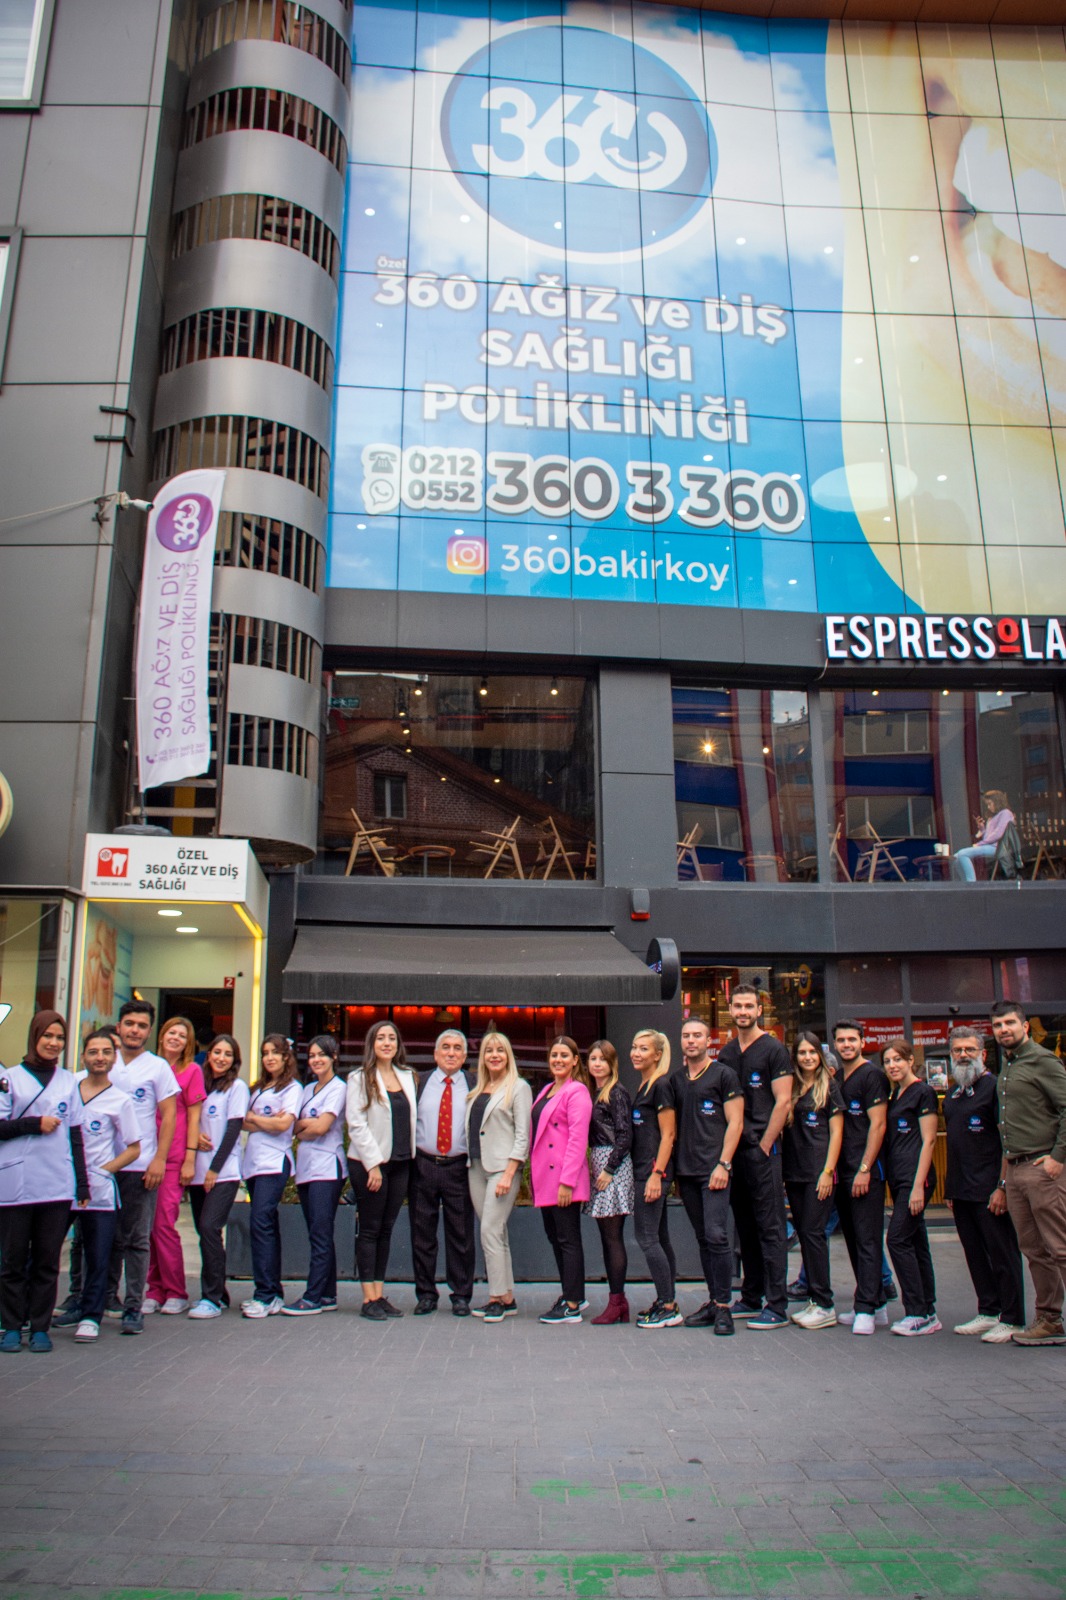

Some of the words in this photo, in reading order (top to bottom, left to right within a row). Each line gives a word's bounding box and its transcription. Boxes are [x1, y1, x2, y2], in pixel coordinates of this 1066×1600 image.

[377, 254, 407, 270] Özel
[374, 274, 478, 311] 360
[493, 275, 618, 323] AĞIZ
[631, 296, 691, 329] ve
[705, 296, 788, 344] DİŞ
[479, 327, 692, 381] SAĞLIĞI
[423, 382, 749, 444] POLİKLİNİĞİ
[408, 451, 476, 477] 0212
[408, 478, 476, 503] 0552
[492, 459, 612, 511] 360
[633, 469, 667, 514] 3
[686, 473, 798, 525] 360
[157, 562, 186, 596] DİŞ
[500, 544, 730, 591] 360bakirkoy
[158, 604, 178, 630] VE
[178, 665, 197, 735] SAĞLIĞI
[153, 697, 172, 740] 360
[177, 847, 208, 860] ÖZEL
[139, 877, 186, 890] SAĞLIĞI
[145, 864, 168, 874] 360
[170, 863, 198, 876] AĞIZ
[201, 866, 216, 876] VE
[219, 864, 239, 880] DİŞ
[226, 978, 233, 987] 2
